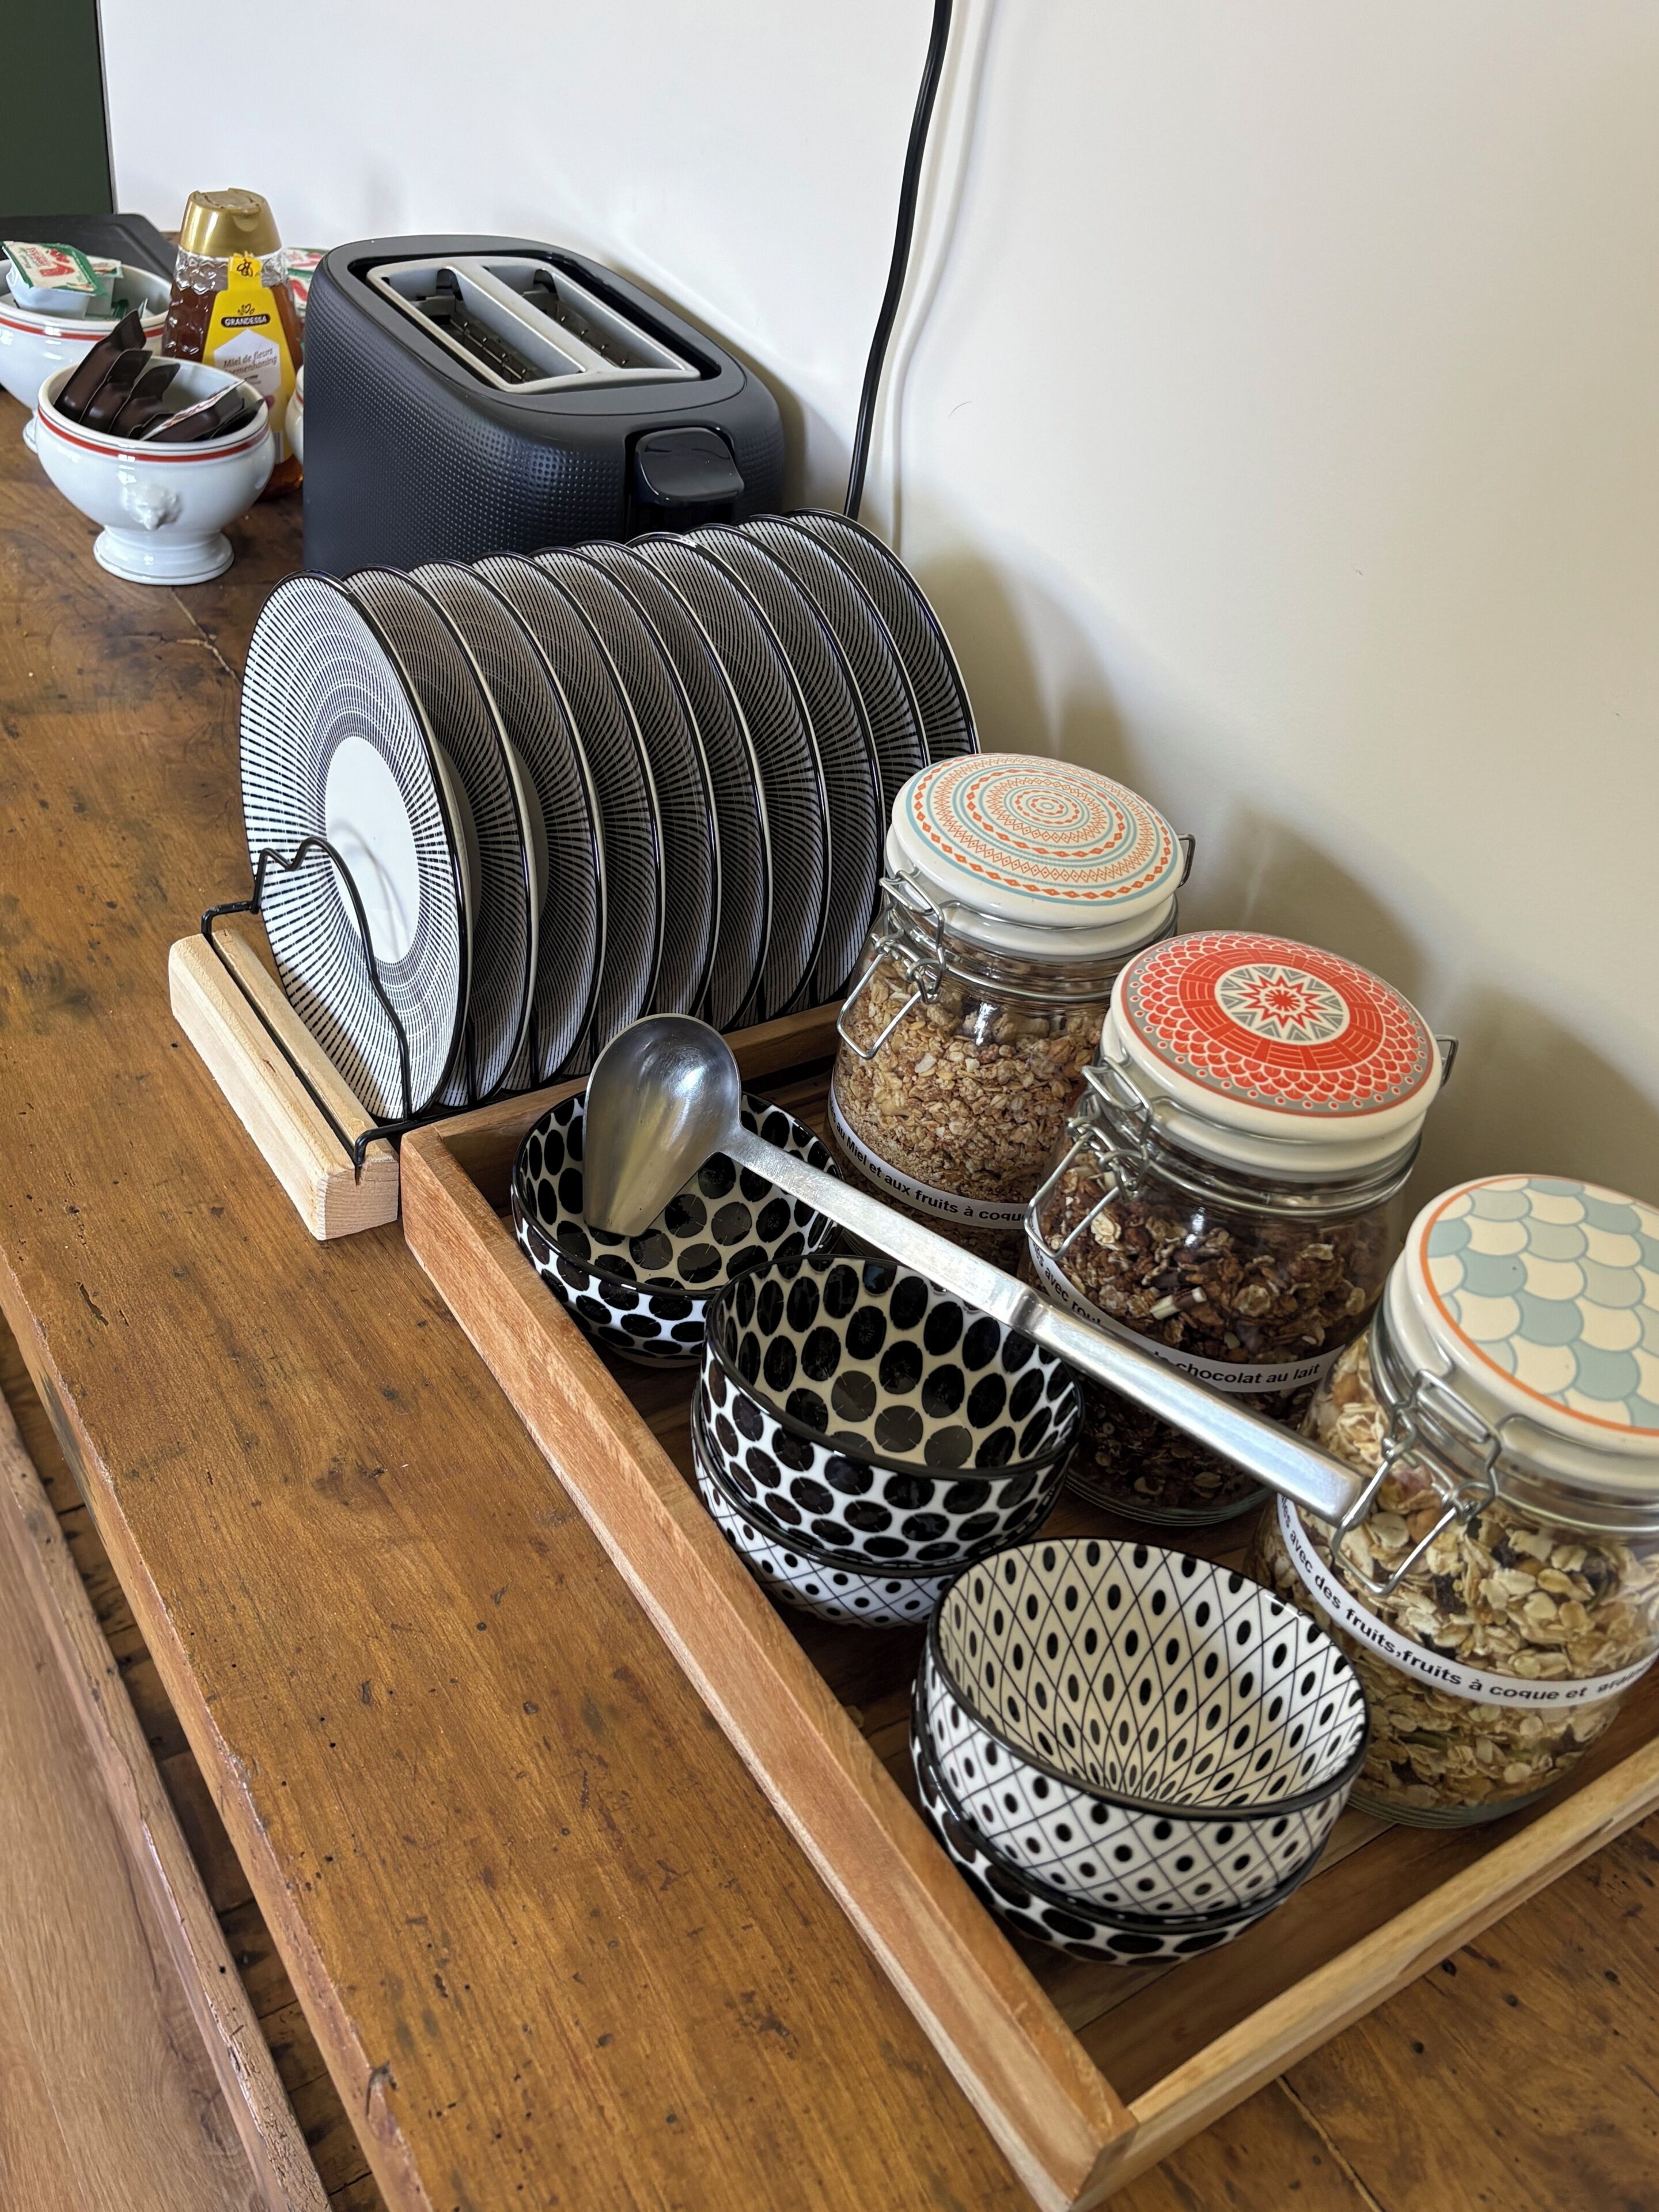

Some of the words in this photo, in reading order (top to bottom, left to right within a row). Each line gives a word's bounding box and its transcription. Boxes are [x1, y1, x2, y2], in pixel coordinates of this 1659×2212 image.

[224, 315, 267, 327] GRANDESSA
[224, 357, 241, 368] Miel
[243, 354, 252, 363] de
[252, 348, 274, 364] fleurs
[836, 1123, 846, 1140] au
[846, 1136, 867, 1165] Miel
[869, 1162, 882, 1178] et
[884, 1175, 911, 1196] aux
[915, 1190, 958, 1213] fruits
[963, 1206, 974, 1217] à
[1044, 1267, 1069, 1302] avec
[1266, 1373, 1289, 1384] au
[1293, 1363, 1321, 1380] lait
[1290, 1530, 1313, 1574] avec
[1315, 1574, 1341, 1609] des
[1468, 1679, 1483, 1692] à
[1489, 1685, 1560, 1700] coque
[1565, 1687, 1588, 1699] et
